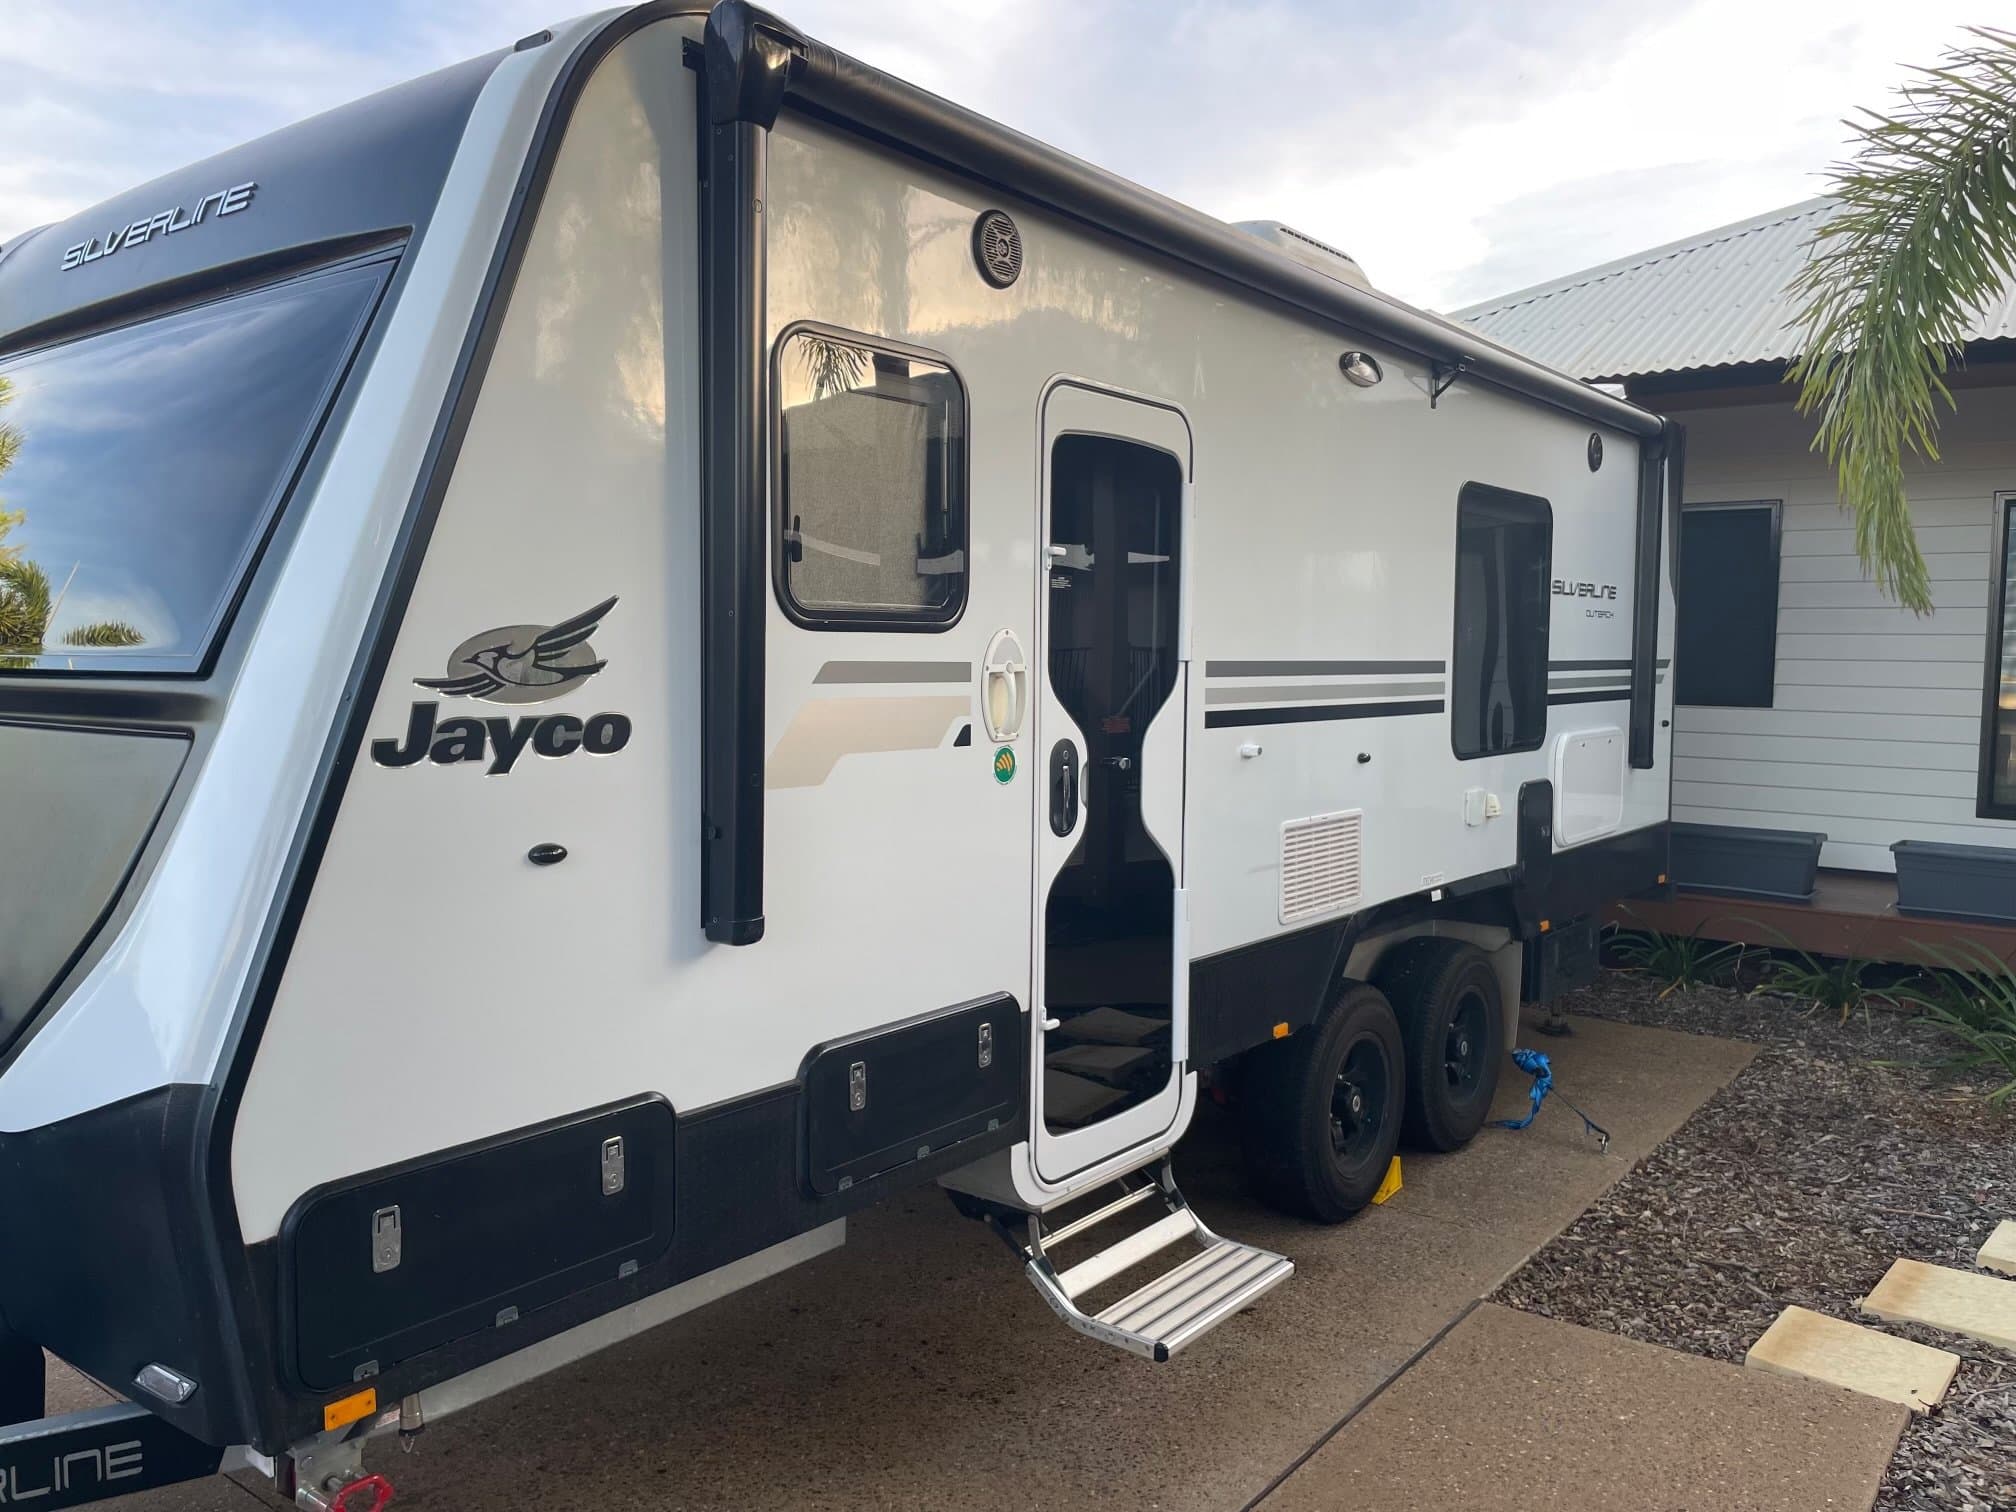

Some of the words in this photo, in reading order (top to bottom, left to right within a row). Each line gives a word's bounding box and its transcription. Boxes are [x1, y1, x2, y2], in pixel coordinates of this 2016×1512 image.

[61, 181, 257, 271] SILVERLINE
[1552, 579, 1617, 600] SILVERLINE
[371, 700, 632, 776] Jayco
[0, 1440, 143, 1503] LINE
